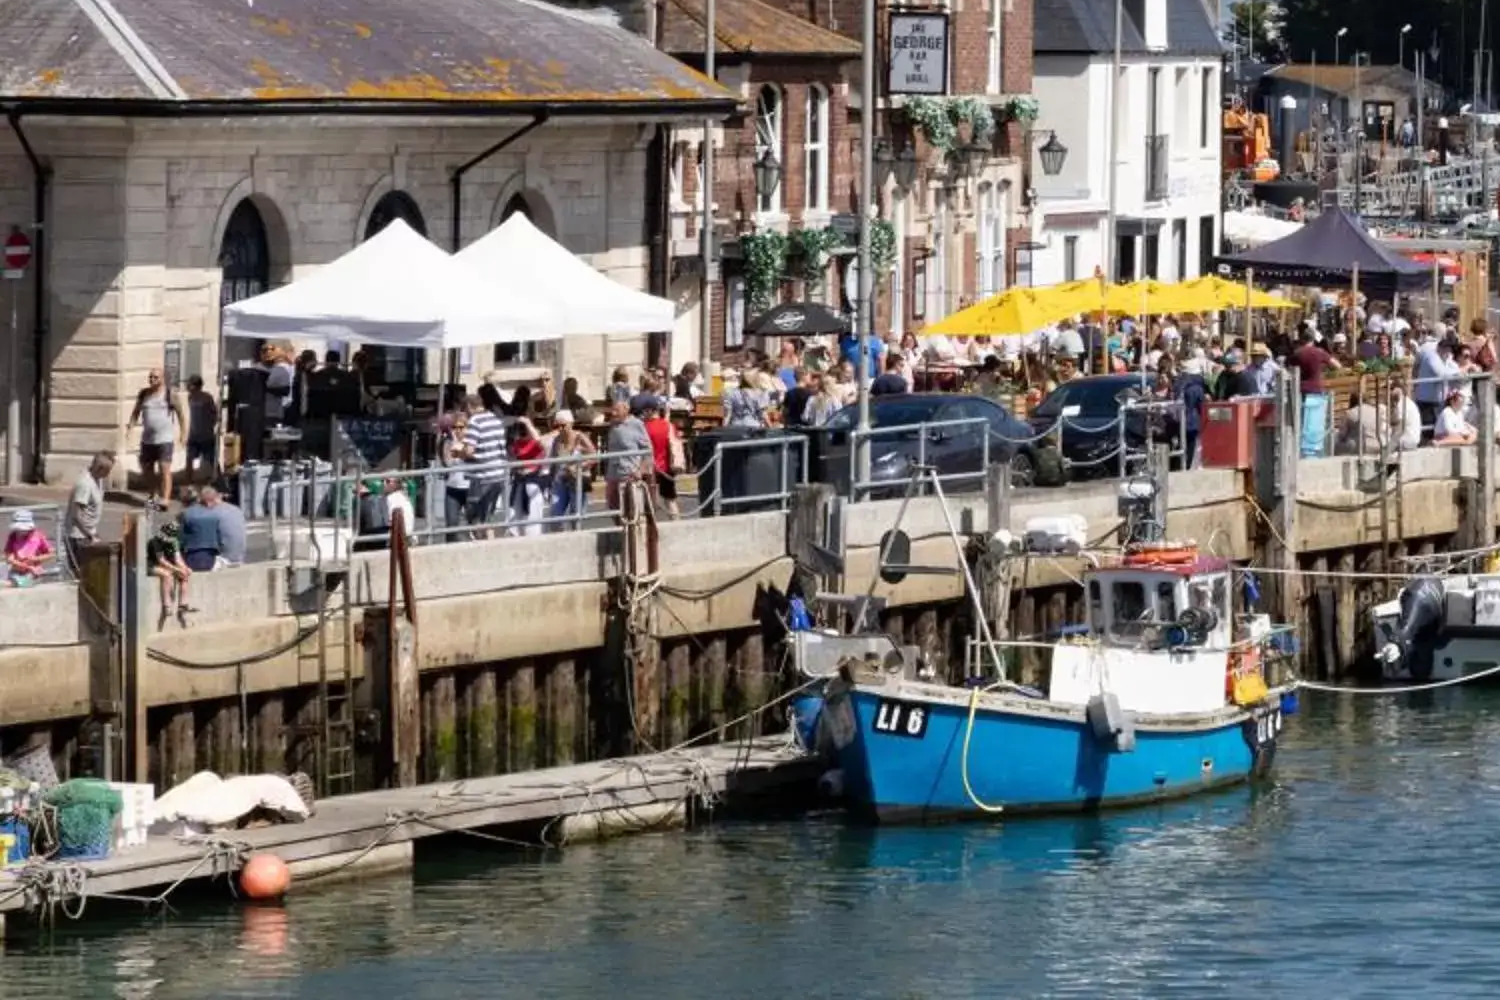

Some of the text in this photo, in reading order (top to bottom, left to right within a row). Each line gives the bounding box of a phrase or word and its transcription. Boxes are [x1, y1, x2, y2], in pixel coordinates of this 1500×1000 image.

[893, 35, 944, 50] GEORGE
[876, 702, 925, 735] LI 6
